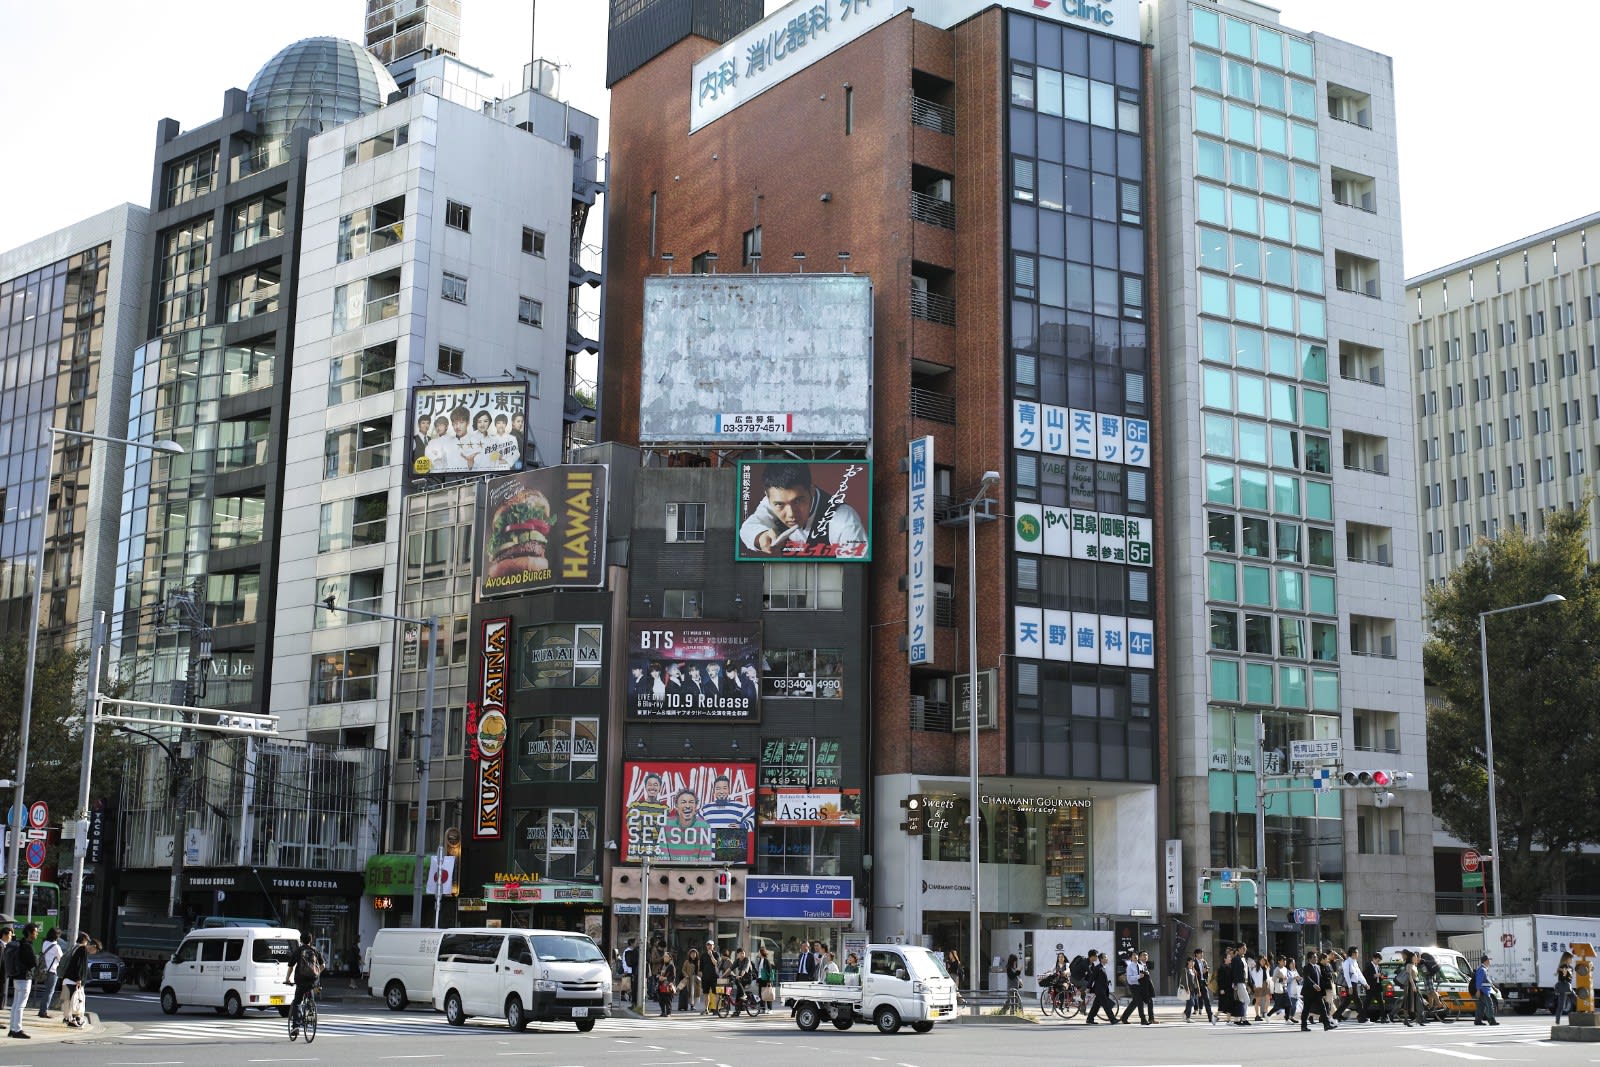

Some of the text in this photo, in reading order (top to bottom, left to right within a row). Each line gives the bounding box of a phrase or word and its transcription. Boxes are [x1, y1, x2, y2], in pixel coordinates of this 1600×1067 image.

[1062, 0, 1114, 26] Clinic
[699, 56, 738, 108] 内科
[745, 2, 831, 78] 消化器科
[723, 424, 786, 433] 03-3797-4571
[735, 416, 775, 424] 広告募集
[1018, 404, 1148, 440] 青山天野 6F
[1020, 428, 1145, 464] クリニック
[562, 472, 593, 578] HAWAII
[911, 445, 926, 643] 青山天野クリニック
[1086, 543, 1149, 562] 表参道 5F
[485, 569, 552, 589] AVOCADO BURGER
[641, 630, 674, 649] BTS
[1020, 622, 1150, 653] 天野歯科 4F
[911, 645, 926, 661] 6F
[210, 658, 254, 676] Viole
[774, 680, 840, 689] 03 3400 4990
[642, 700, 664, 709] Blu-ray
[666, 694, 693, 708] 10.9
[698, 694, 749, 708] Release
[480, 762, 501, 829] KUA
[922, 797, 954, 809] Sweets
[981, 795, 1091, 808] CHARMANT GOURMAND
[34, 809, 45, 821] 40
[628, 808, 668, 826] 2nd
[780, 801, 829, 820] Asias
[93, 812, 101, 835] TACO
[927, 818, 949, 832] Cafe
[628, 827, 712, 845] SEASON
[272, 879, 338, 889] TOMOKO KODERA
[494, 873, 539, 882] HAWAII
[770, 883, 810, 893] 外貨両替
[803, 910, 831, 918] Travelex
